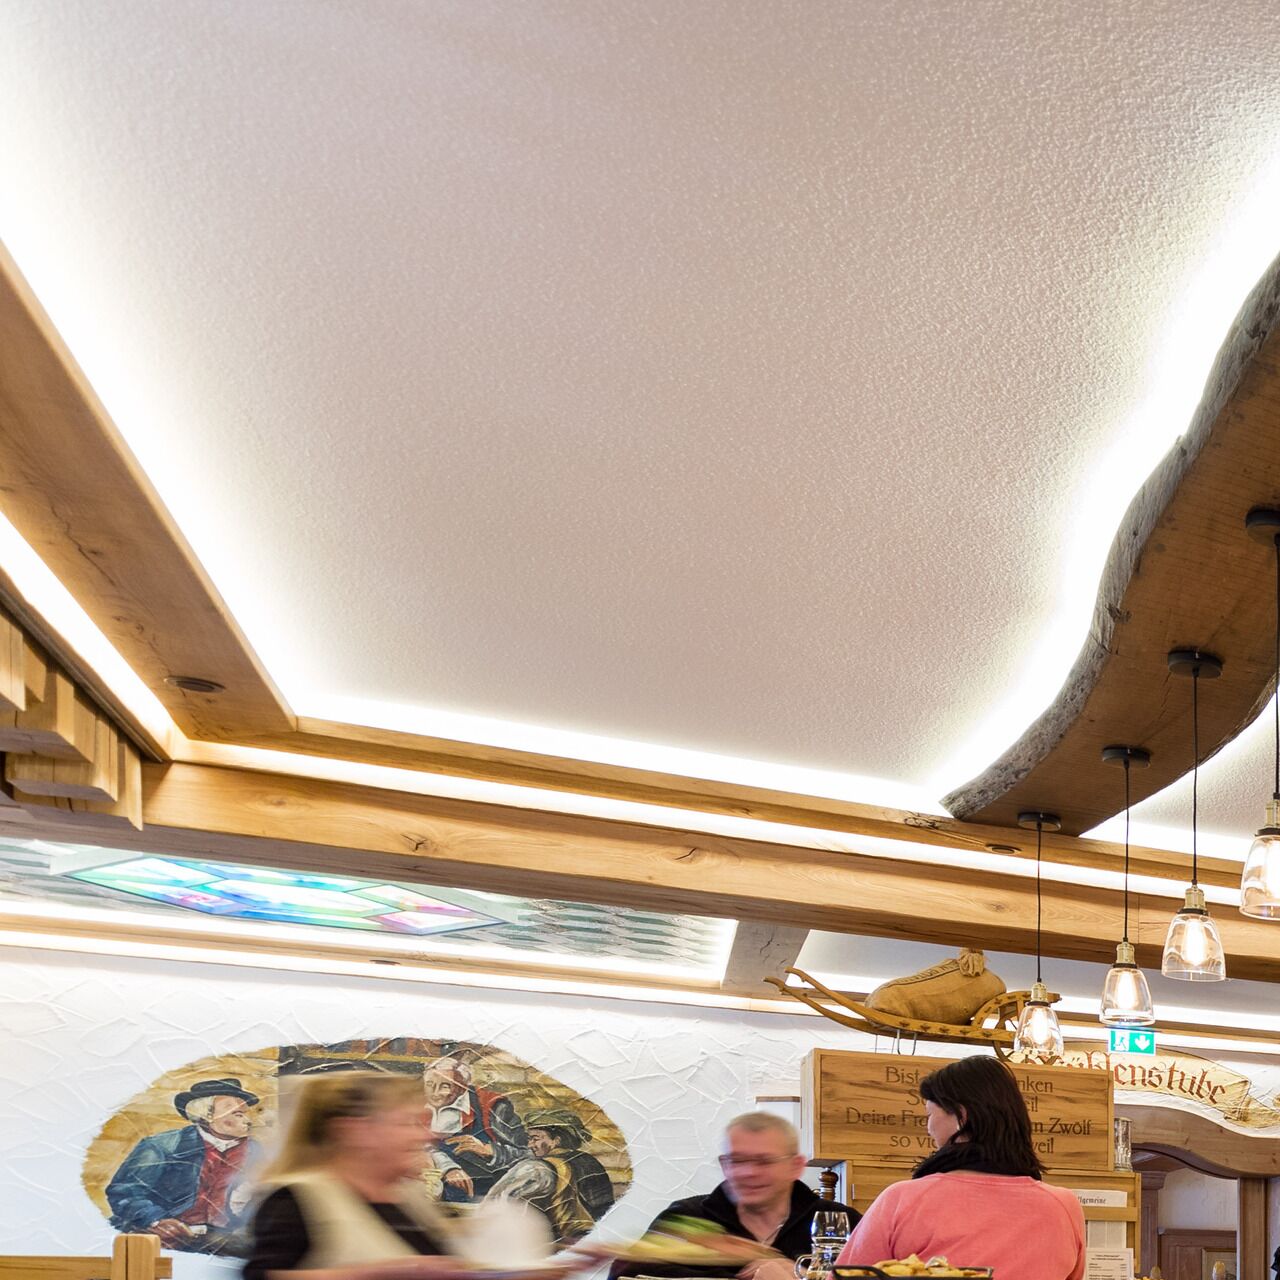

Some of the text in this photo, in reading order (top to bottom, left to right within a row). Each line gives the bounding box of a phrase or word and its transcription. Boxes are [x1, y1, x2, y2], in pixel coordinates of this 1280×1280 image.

[885, 1066, 920, 1084] Bist
[846, 1107, 896, 1127] Deine
[1049, 1118, 1092, 1136] Zwölf
